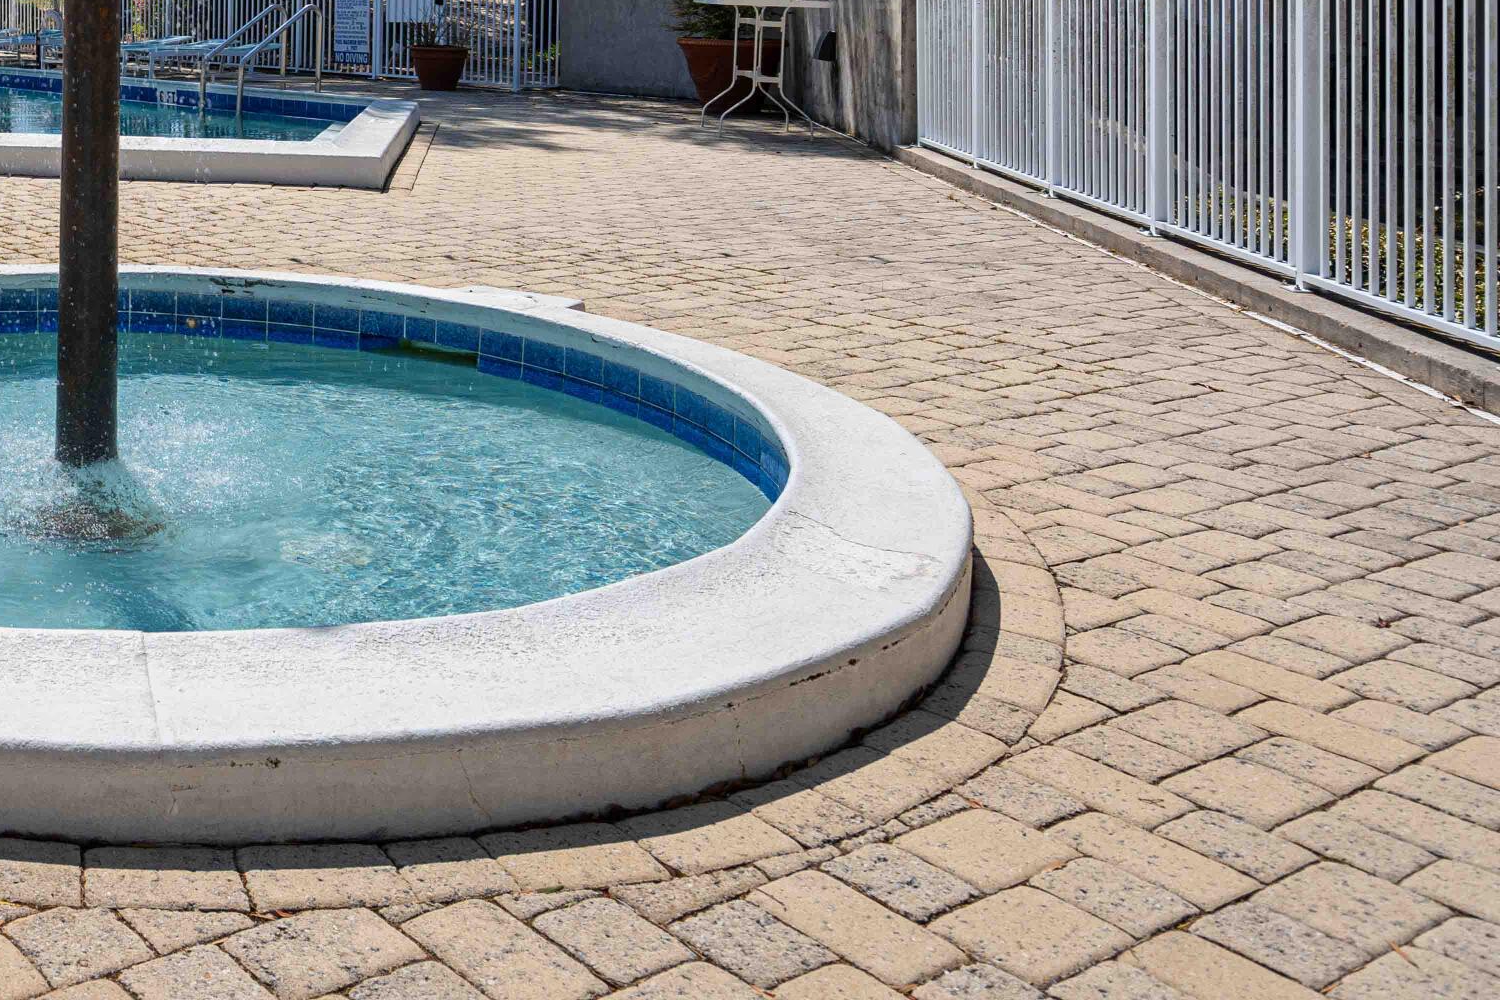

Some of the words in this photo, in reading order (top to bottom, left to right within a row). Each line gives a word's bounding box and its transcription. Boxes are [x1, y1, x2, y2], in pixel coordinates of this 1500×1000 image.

[335, 53, 344, 63] NO
[345, 53, 368, 64] DIVING
[166, 91, 176, 104] FT
